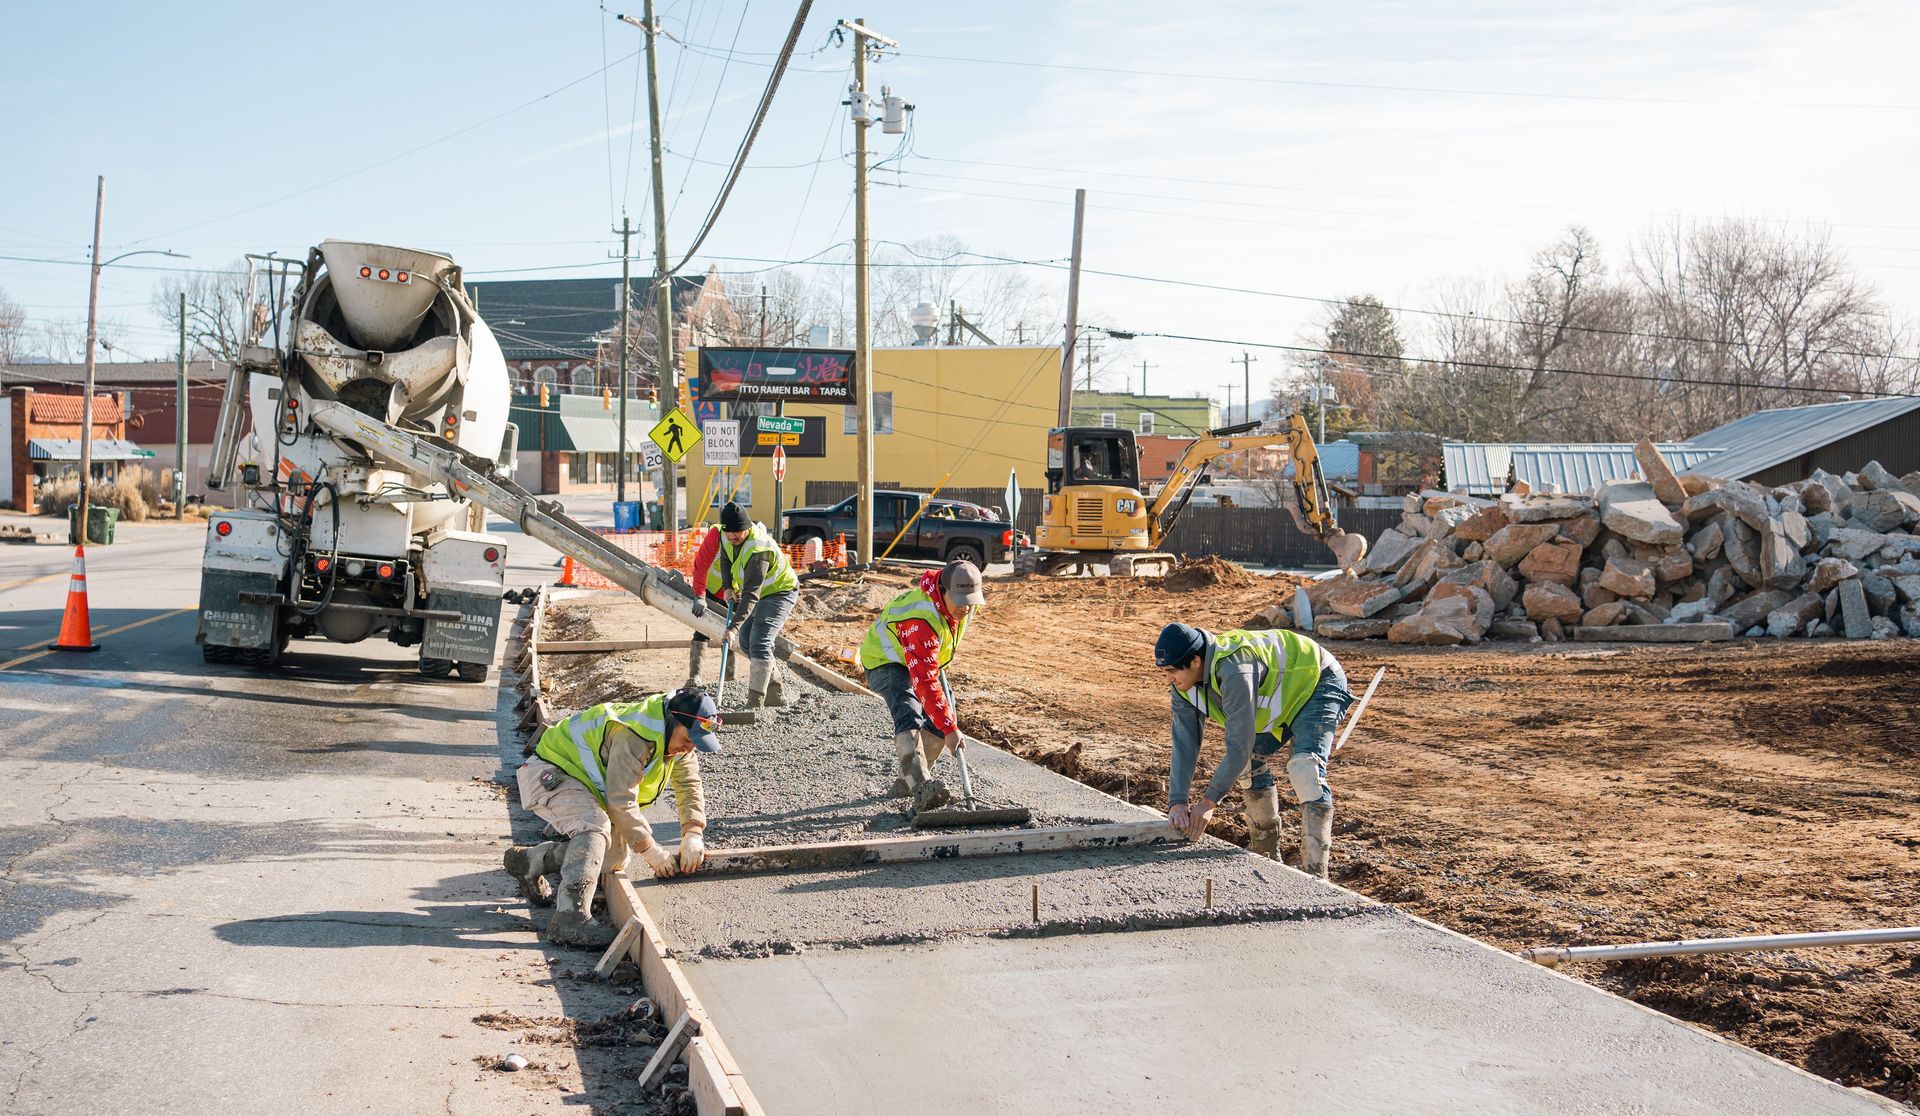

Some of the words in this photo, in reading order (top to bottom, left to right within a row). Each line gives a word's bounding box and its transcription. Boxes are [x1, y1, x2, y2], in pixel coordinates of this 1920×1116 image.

[740, 385, 758, 394] ITTO
[760, 385, 791, 394] RAMEN
[792, 386, 810, 395] BAR
[811, 387, 818, 395] &
[819, 387, 846, 396] TAPAS
[759, 417, 792, 431] Nevada
[706, 426, 717, 436] DO
[720, 426, 736, 436] NOT
[708, 439, 735, 448] BLOCK
[1218, 440, 1230, 449] CAT
[646, 454, 663, 467] 20
[705, 451, 738, 460] INTERSECTION
[1116, 498, 1137, 513] CAT
[436, 621, 467, 631] READY
[468, 625, 489, 637] MIX
[445, 643, 458, 651] WITH
